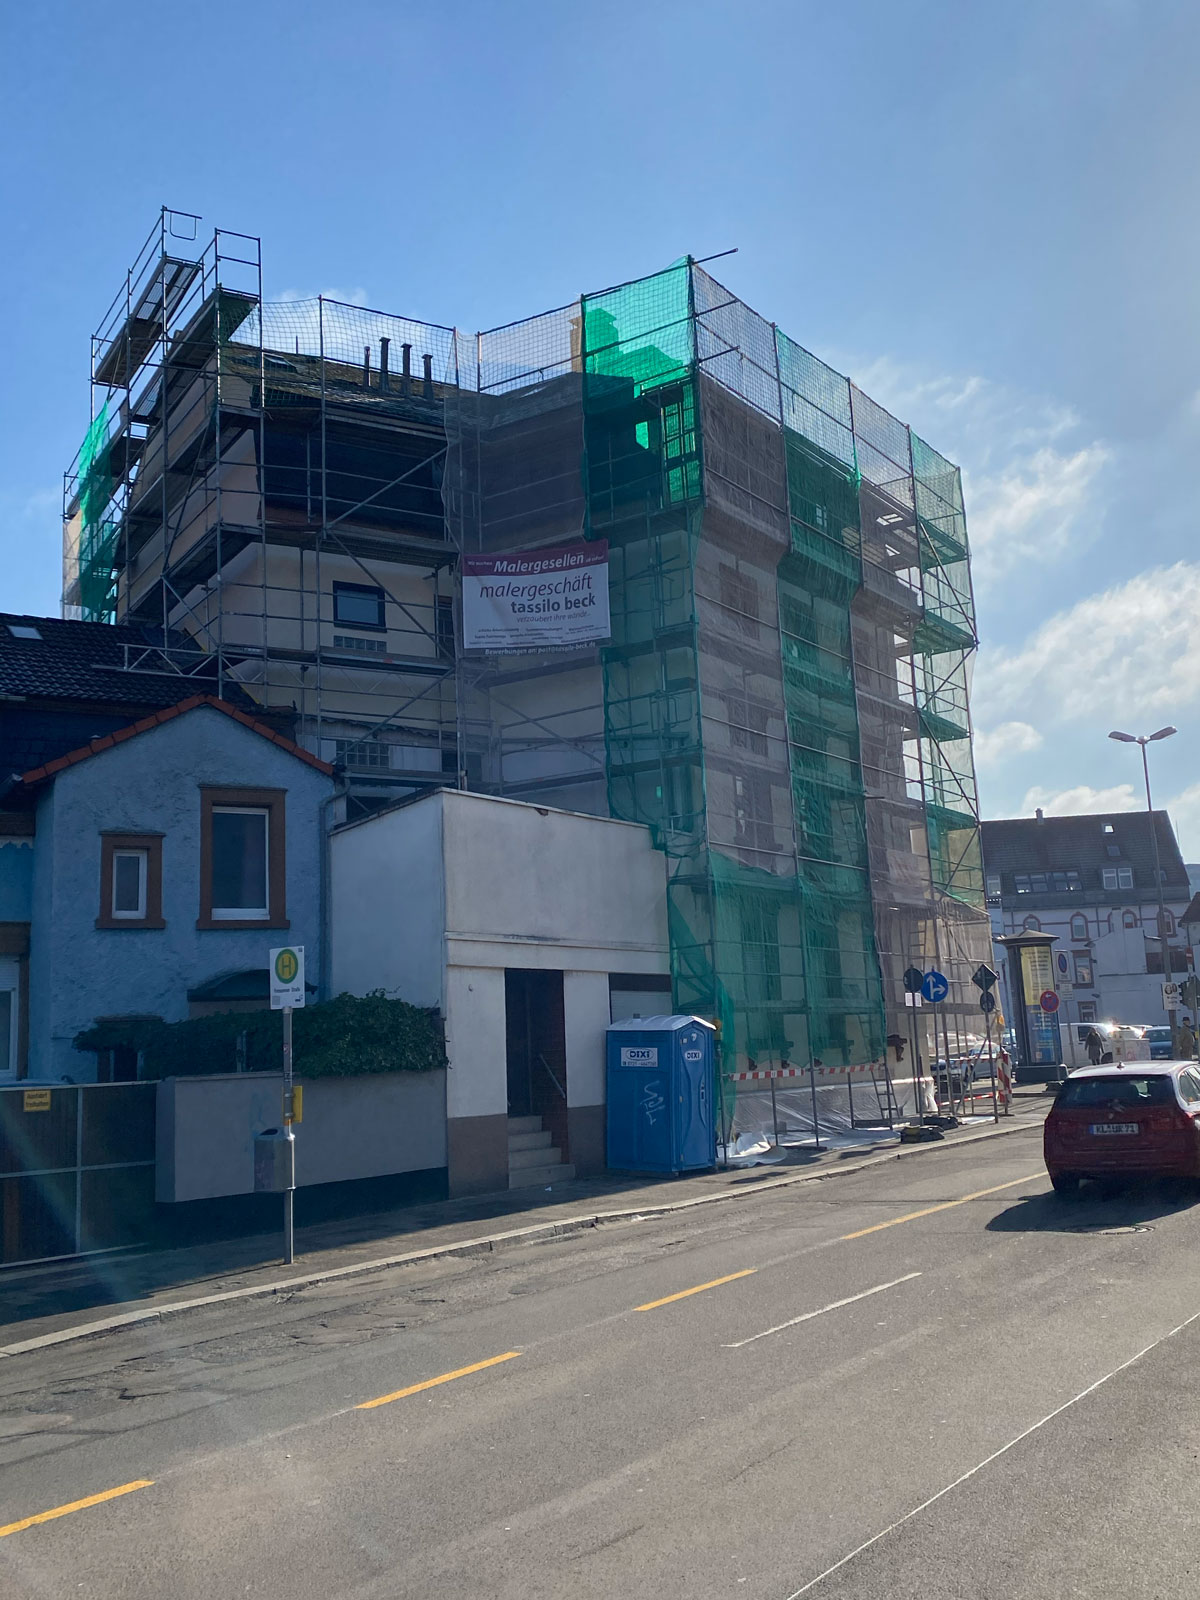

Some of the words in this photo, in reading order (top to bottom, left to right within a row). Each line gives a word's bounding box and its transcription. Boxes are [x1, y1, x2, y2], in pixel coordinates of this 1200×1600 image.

[493, 553, 584, 574] Malergesellen
[480, 572, 593, 602] malergeschäft
[511, 599, 561, 614] tassilo
[565, 592, 596, 611] beck
[516, 615, 552, 624] verzaubert
[553, 613, 567, 622] ihre
[484, 648, 527, 656] Bewerbungen
[281, 955, 292, 978] H
